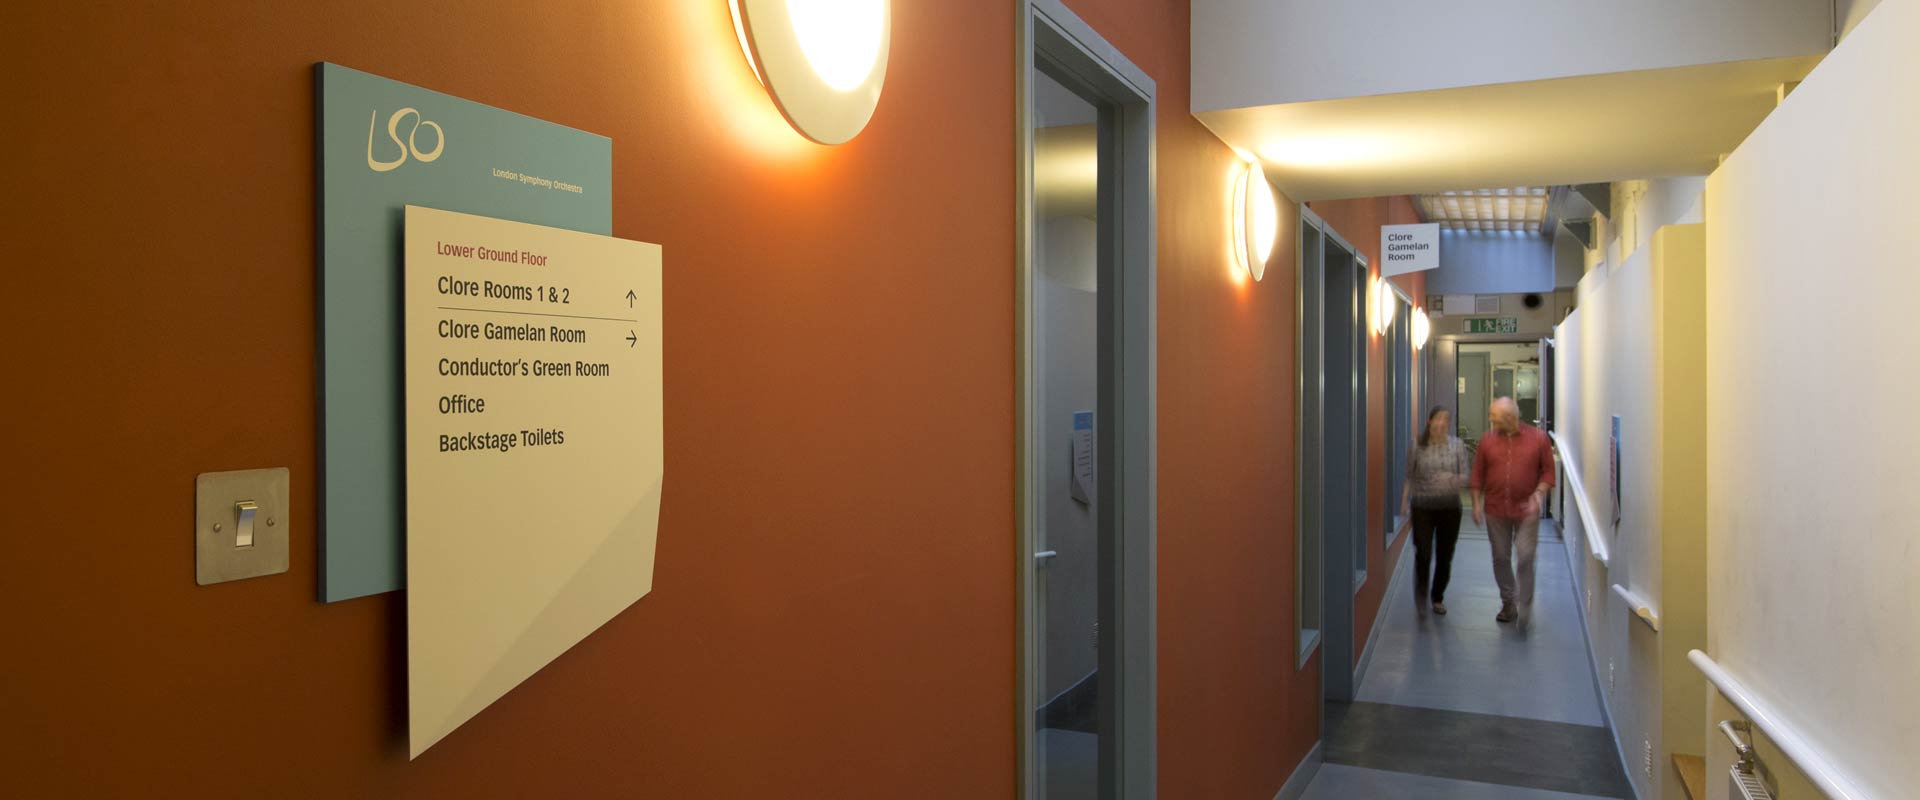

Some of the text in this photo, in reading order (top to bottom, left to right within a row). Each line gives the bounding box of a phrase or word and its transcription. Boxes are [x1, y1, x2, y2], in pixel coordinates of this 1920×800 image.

[367, 107, 445, 172] LSO
[492, 167, 583, 194] London Symphony Orchestra
[1388, 233, 1413, 242] Clore
[1388, 242, 1429, 251] Gamelan
[437, 241, 547, 267] Lower Ground Floor
[1388, 253, 1415, 261] Room
[437, 275, 570, 304] Clore Rooms 1 & 2
[438, 319, 586, 343] Clore Gamelan Room
[438, 357, 610, 377] Conductor's Green Room
[438, 394, 485, 414] Office
[439, 428, 564, 453] Backstage Toilets
